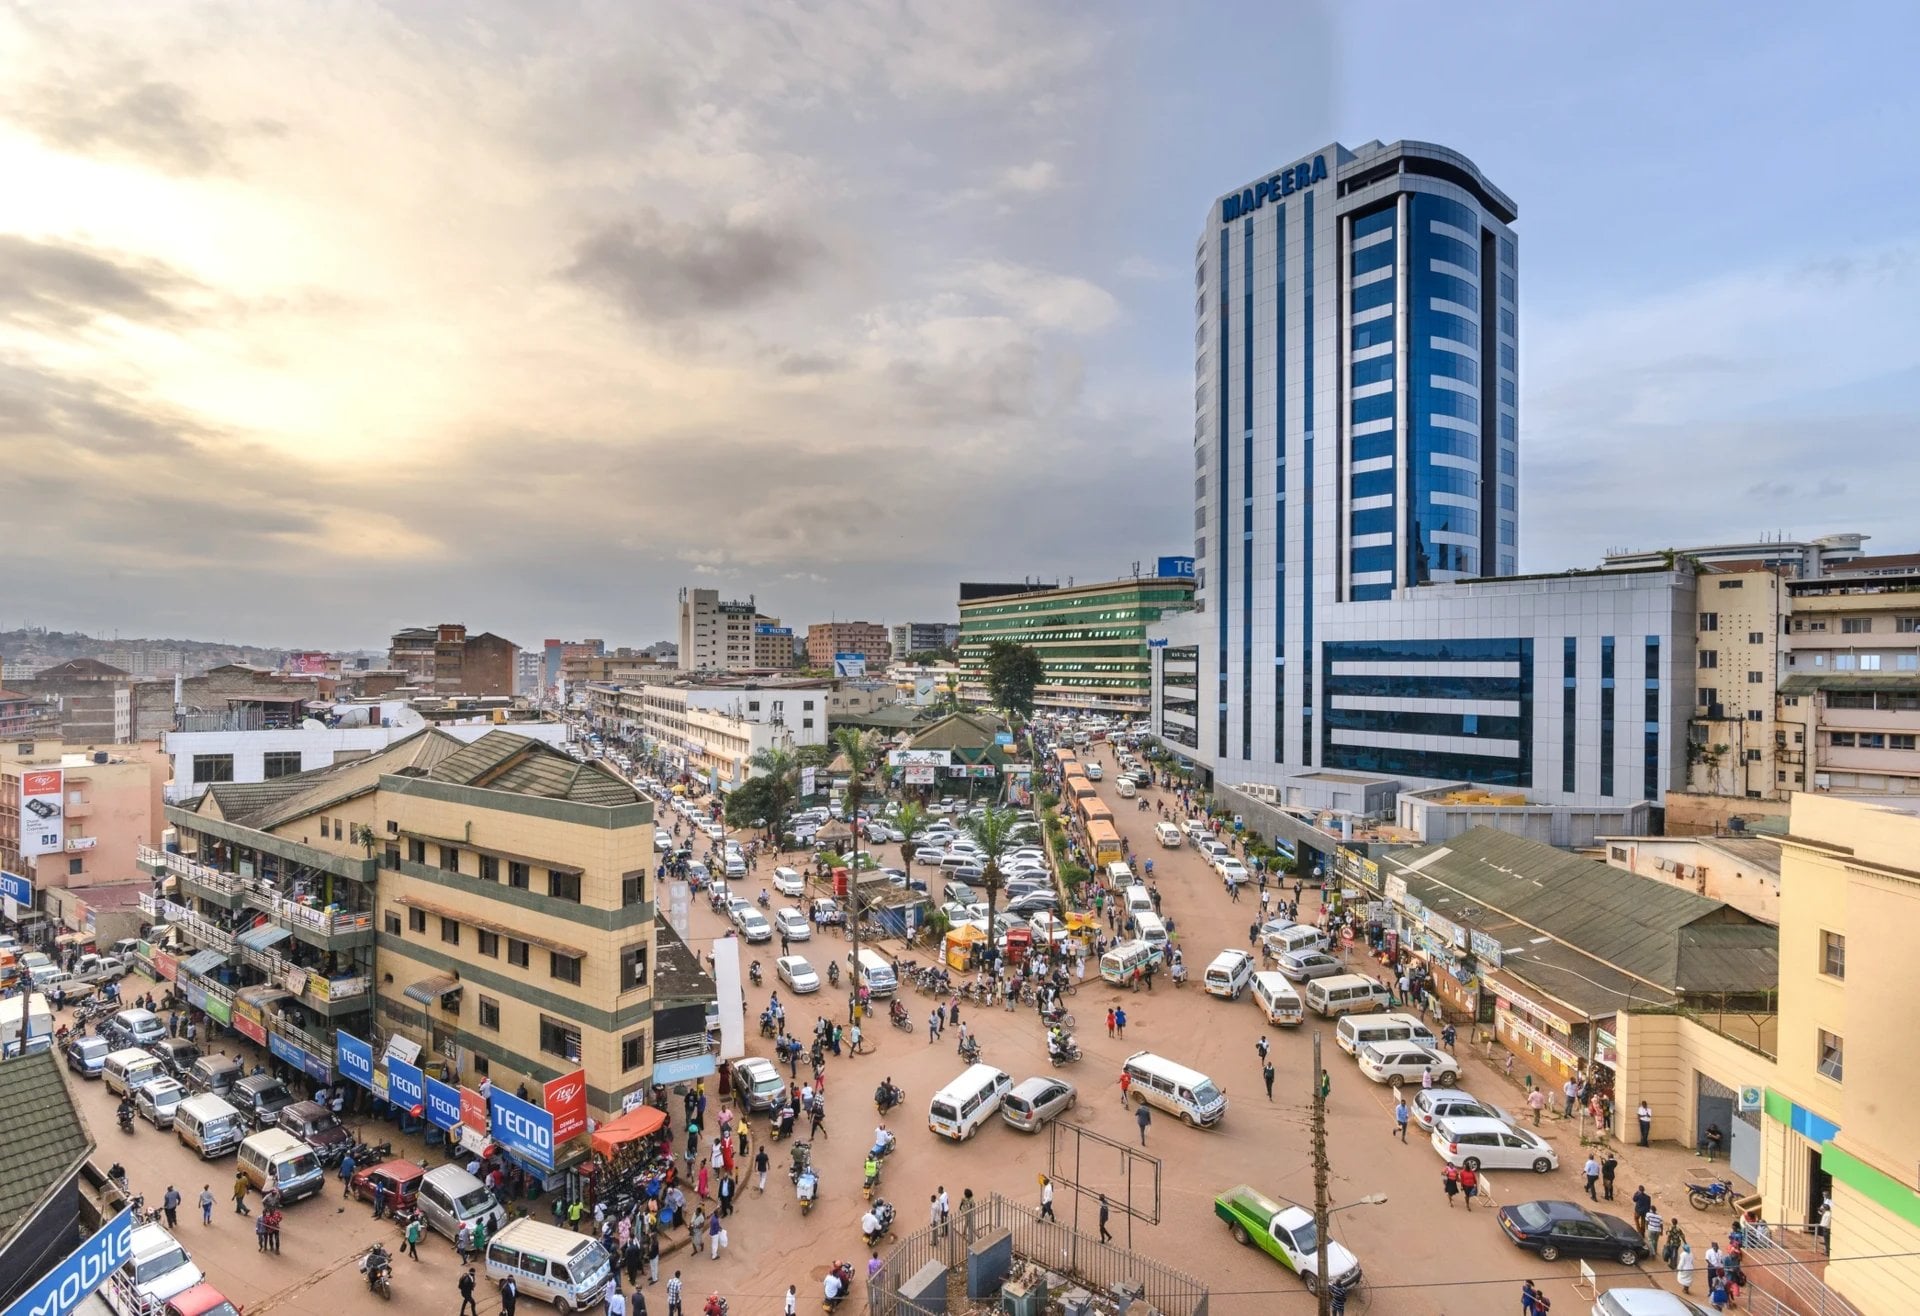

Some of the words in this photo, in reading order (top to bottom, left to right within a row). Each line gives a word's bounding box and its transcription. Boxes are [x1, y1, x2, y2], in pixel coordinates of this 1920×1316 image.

[1222, 154, 1328, 223] MAPEERA
[341, 1048, 369, 1072] TECNO
[390, 1072, 421, 1099] TECNO
[430, 1094, 460, 1120] TECNO
[494, 1104, 550, 1149] TECNO
